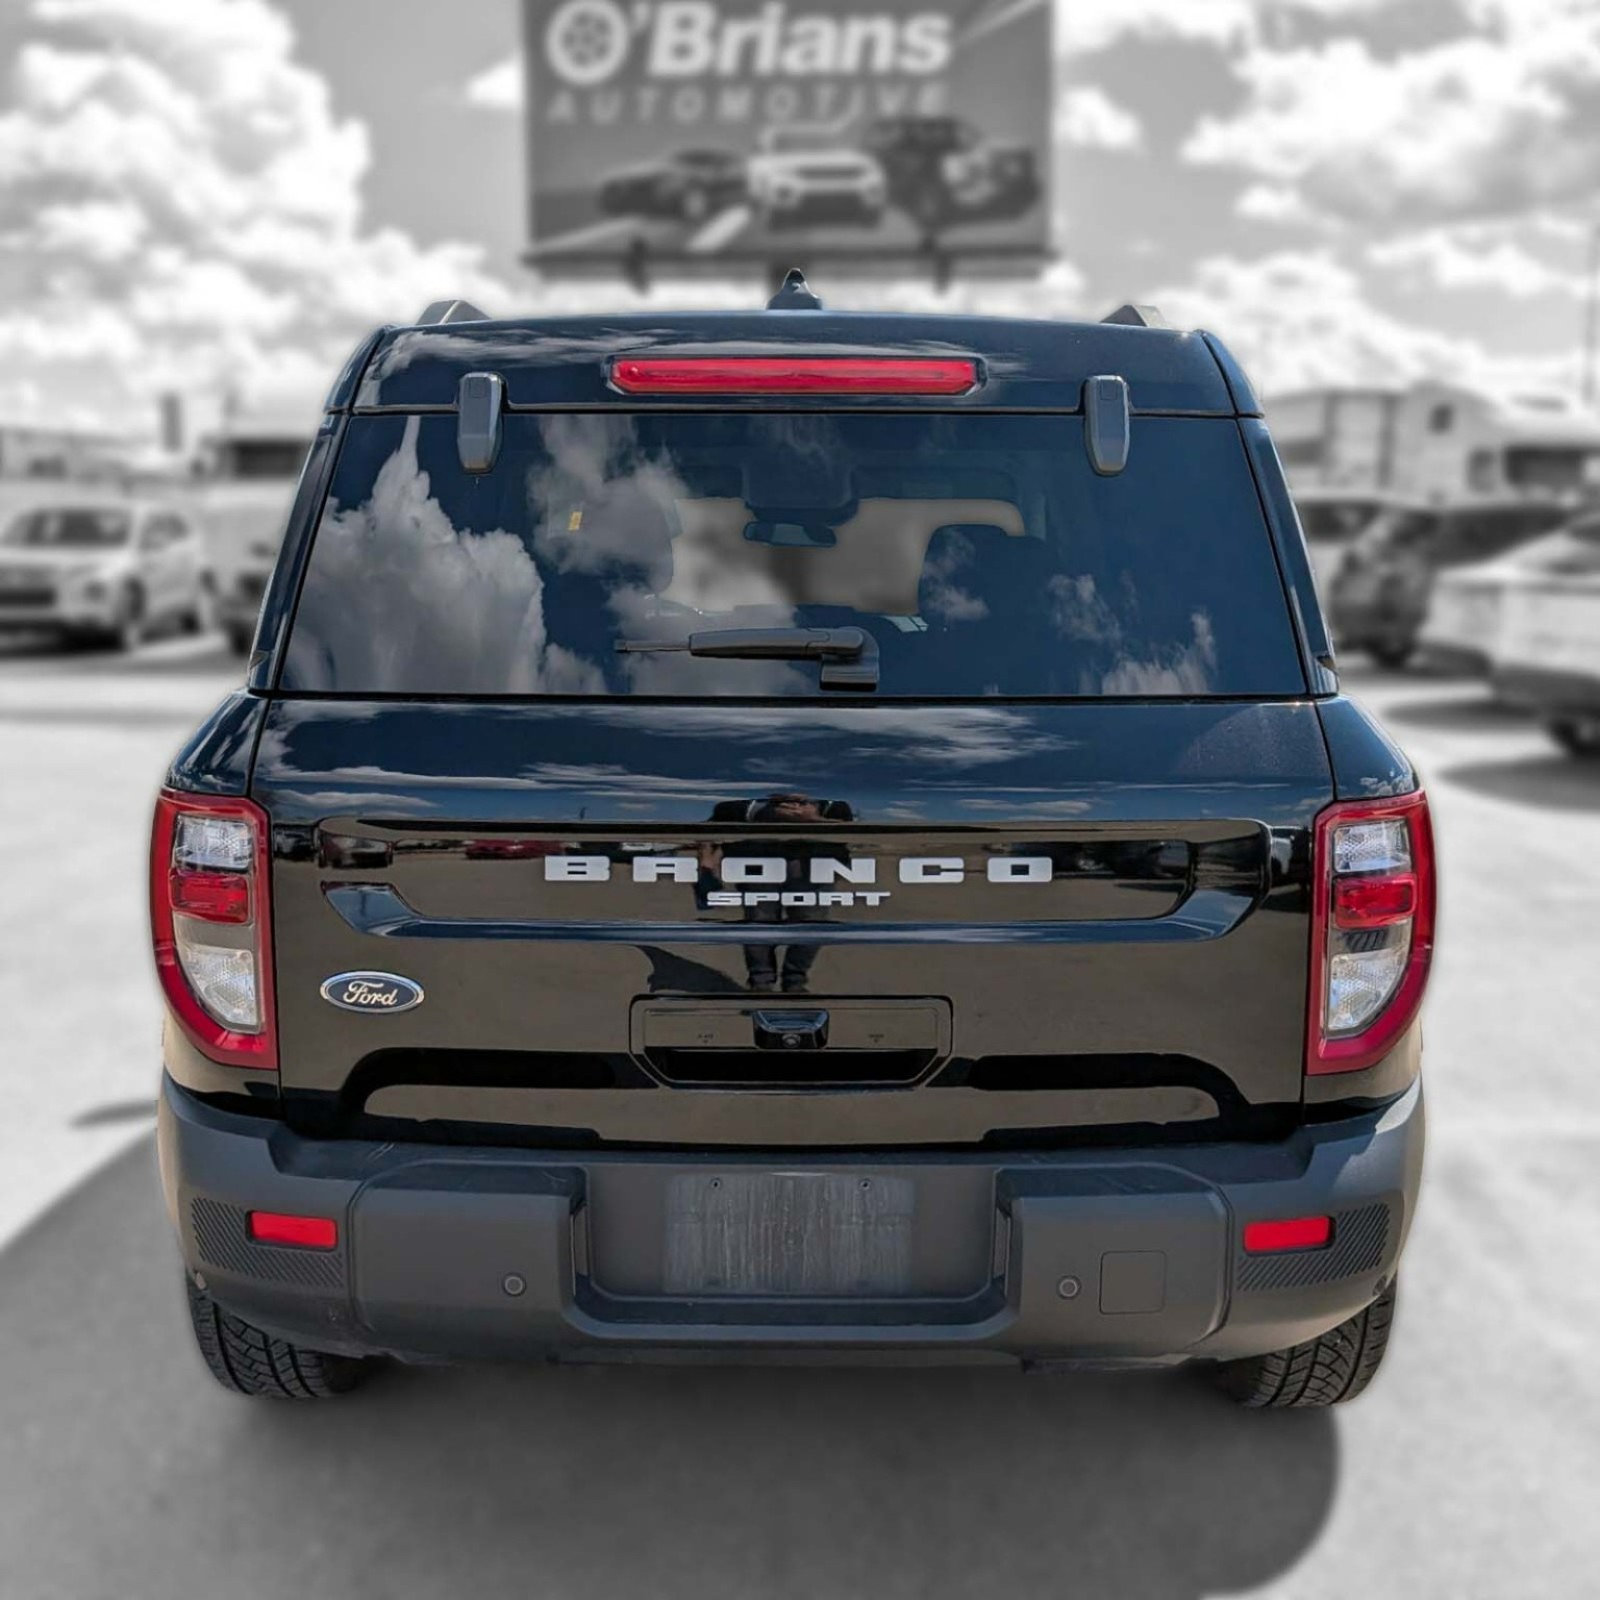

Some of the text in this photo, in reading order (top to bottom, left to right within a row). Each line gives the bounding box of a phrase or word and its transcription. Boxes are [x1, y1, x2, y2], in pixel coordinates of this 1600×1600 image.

[547, 0, 952, 83] O'Brians
[548, 86, 945, 121] AUTOMOTIVE
[544, 856, 1053, 883] BRONCO
[707, 891, 891, 907] SPORT
[343, 980, 398, 1005] Ford
